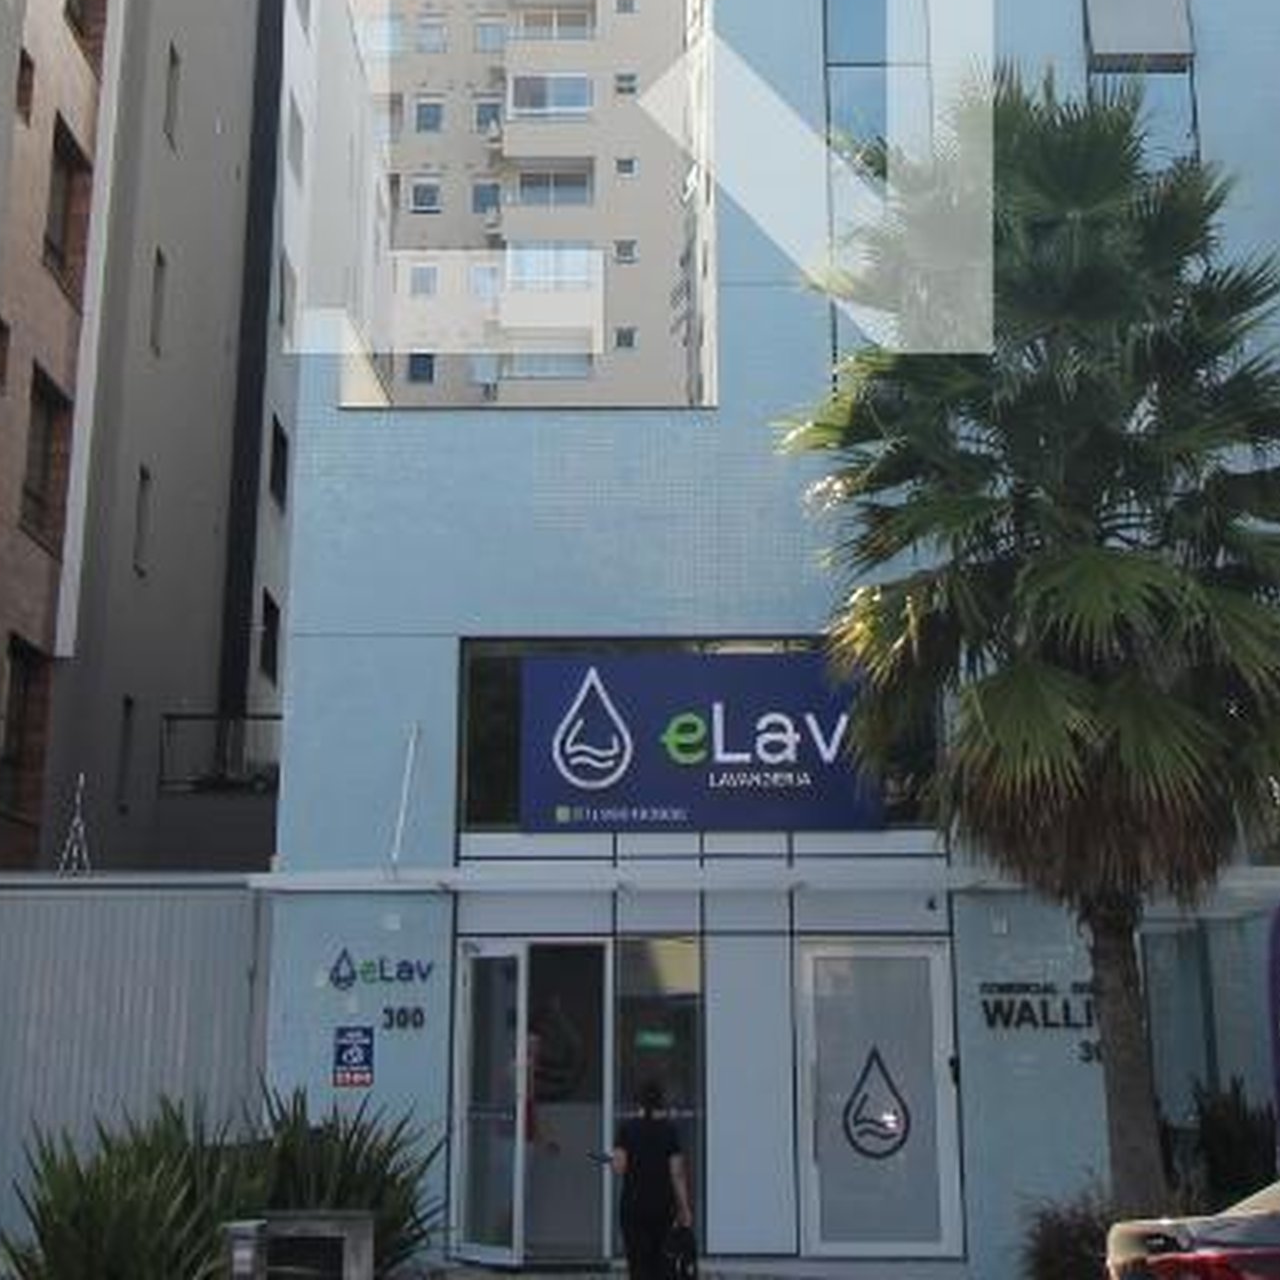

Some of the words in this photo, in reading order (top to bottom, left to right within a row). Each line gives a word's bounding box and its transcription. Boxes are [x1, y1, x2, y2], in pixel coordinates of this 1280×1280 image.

[660, 702, 849, 764] eLav
[359, 957, 434, 984] eLav
[382, 1007, 424, 1030] 300
[982, 1000, 1095, 1028] WALLI
